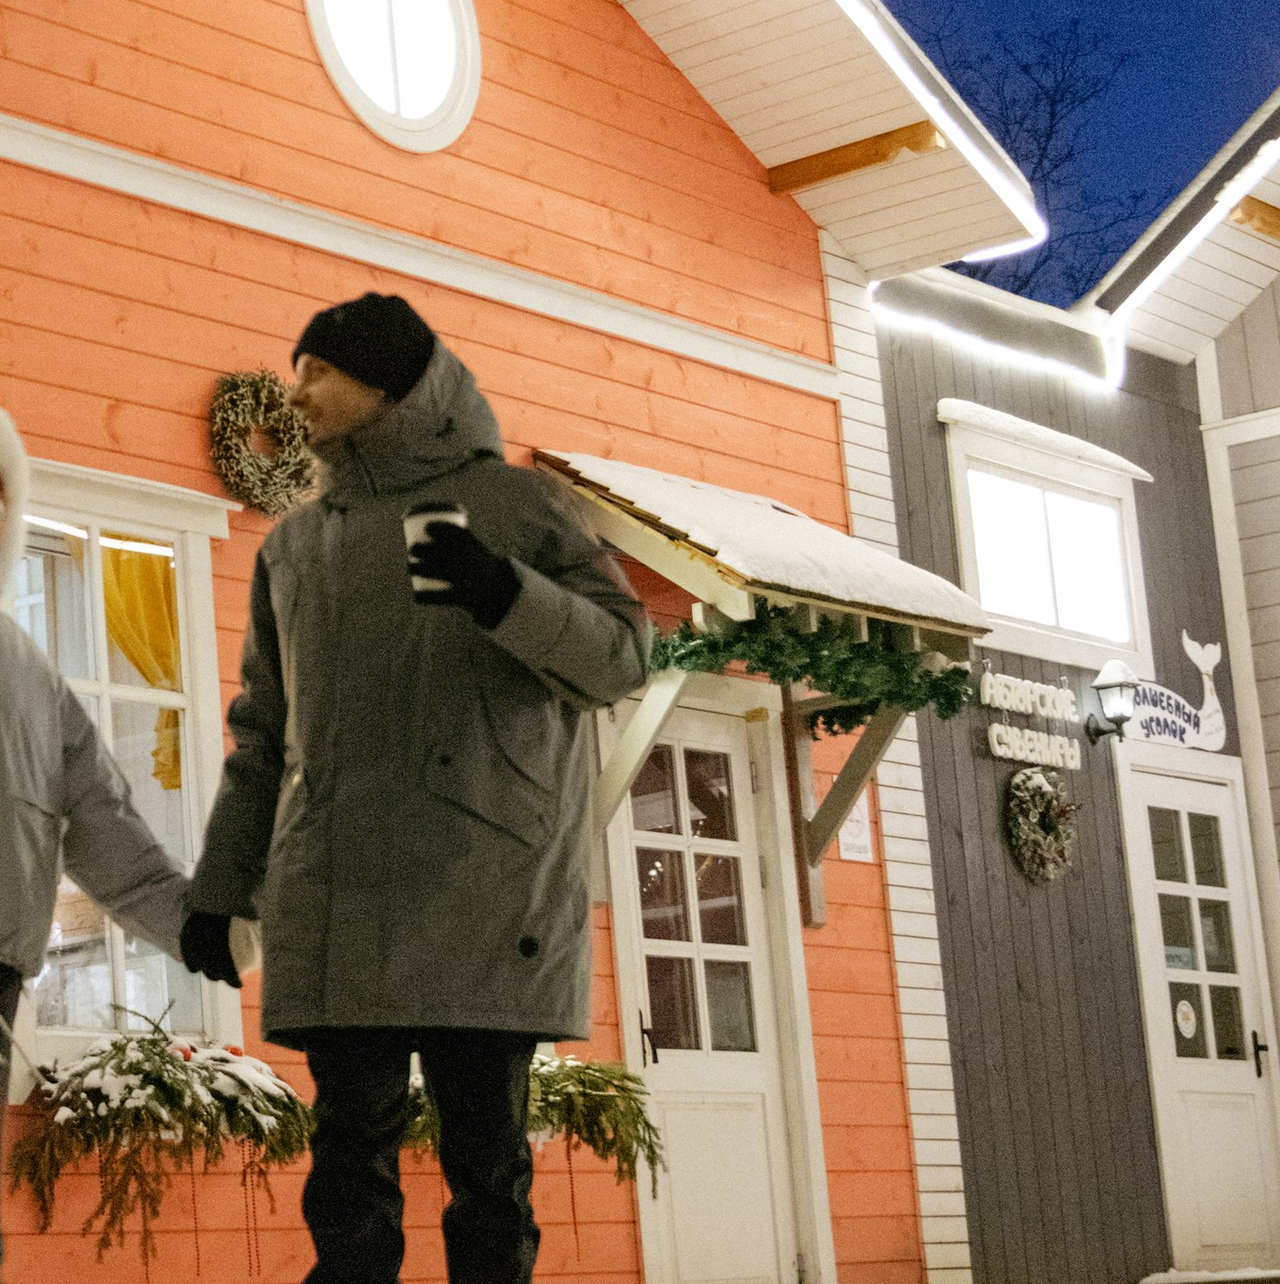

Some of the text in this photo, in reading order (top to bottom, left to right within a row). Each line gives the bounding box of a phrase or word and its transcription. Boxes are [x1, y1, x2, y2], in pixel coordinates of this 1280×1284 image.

[981, 672, 1079, 722] АВТОРСКИЕ
[988, 723, 1081, 770] СУВЕНИРЫ
[1140, 716, 1186, 744] УГОЛОК
